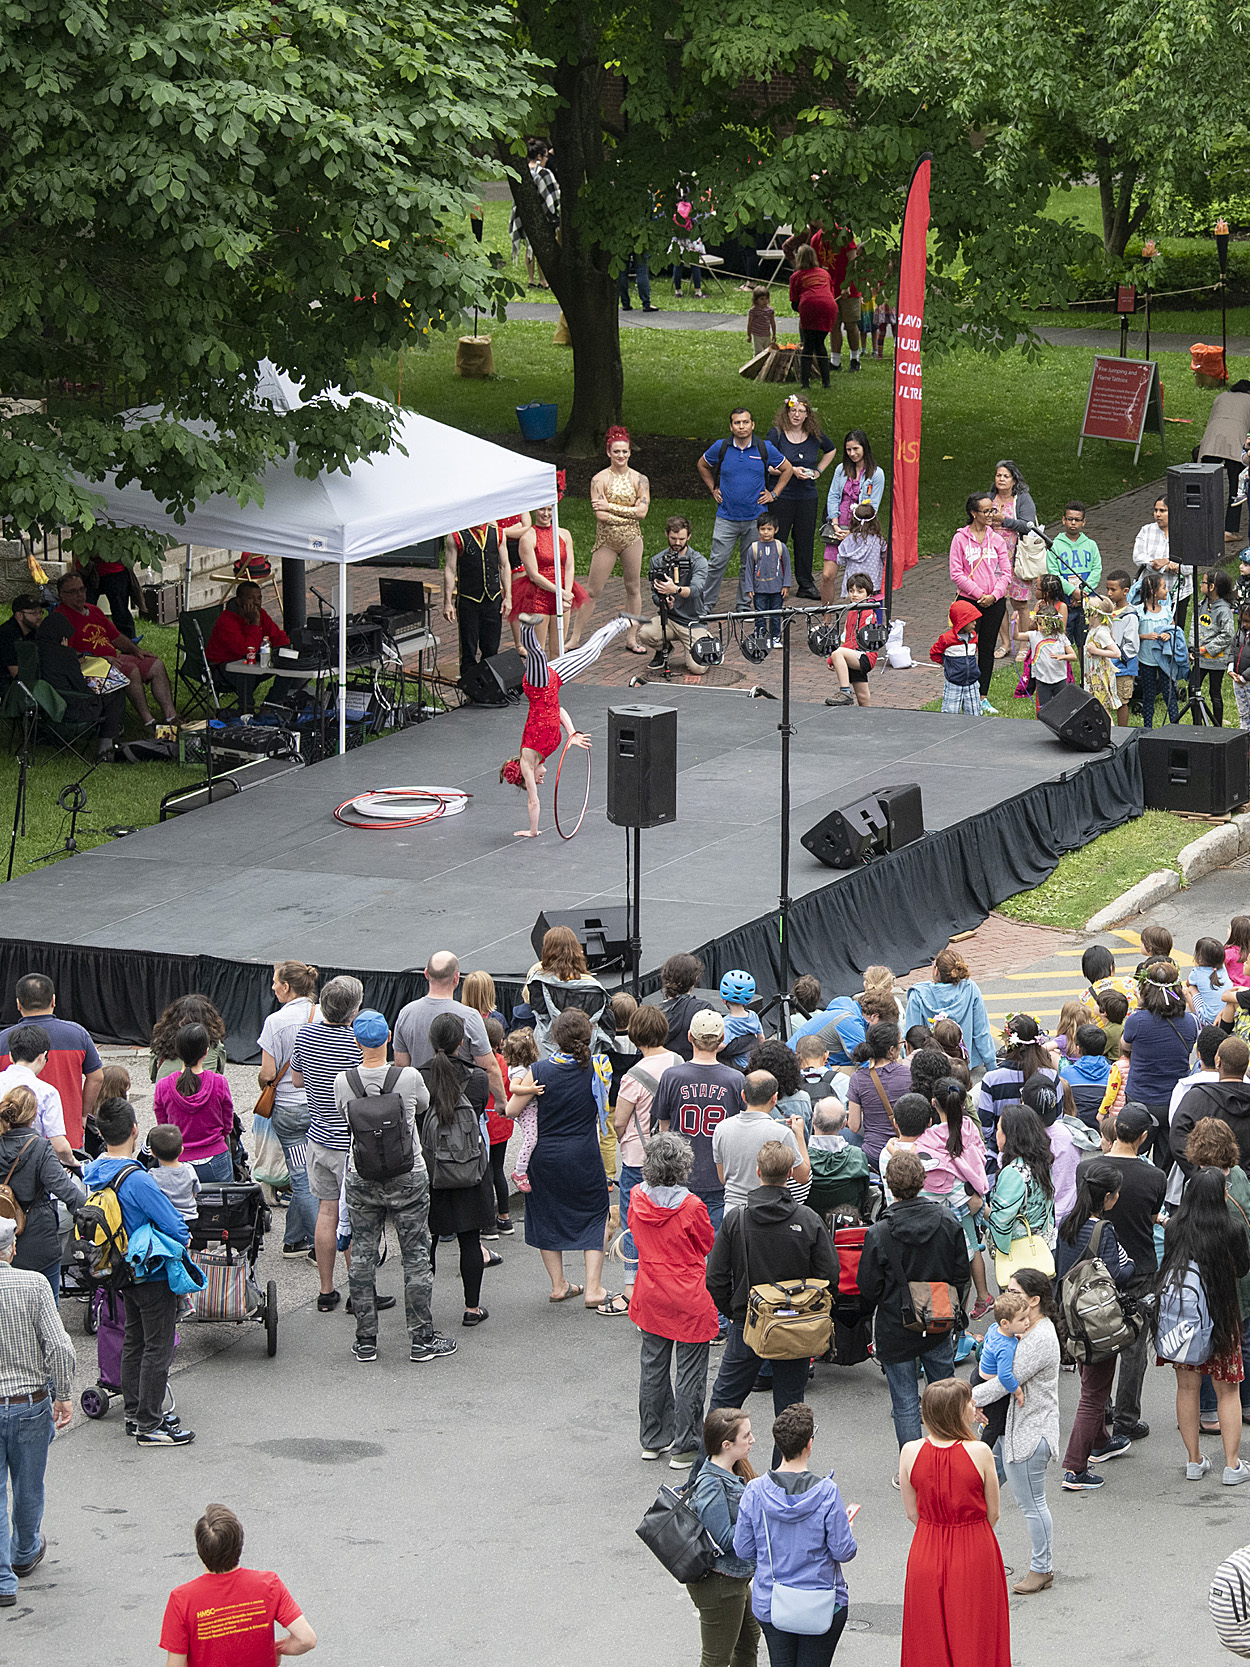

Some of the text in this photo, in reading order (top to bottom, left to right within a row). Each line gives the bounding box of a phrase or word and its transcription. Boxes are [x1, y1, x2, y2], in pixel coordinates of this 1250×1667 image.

[1108, 367, 1127, 376] Jumping
[1060, 549, 1092, 571] GAP
[680, 1084, 729, 1101] STAFF
[679, 1104, 727, 1138] 08
[1160, 1320, 1192, 1357] NIKE
[197, 1607, 216, 1619] HMSC
